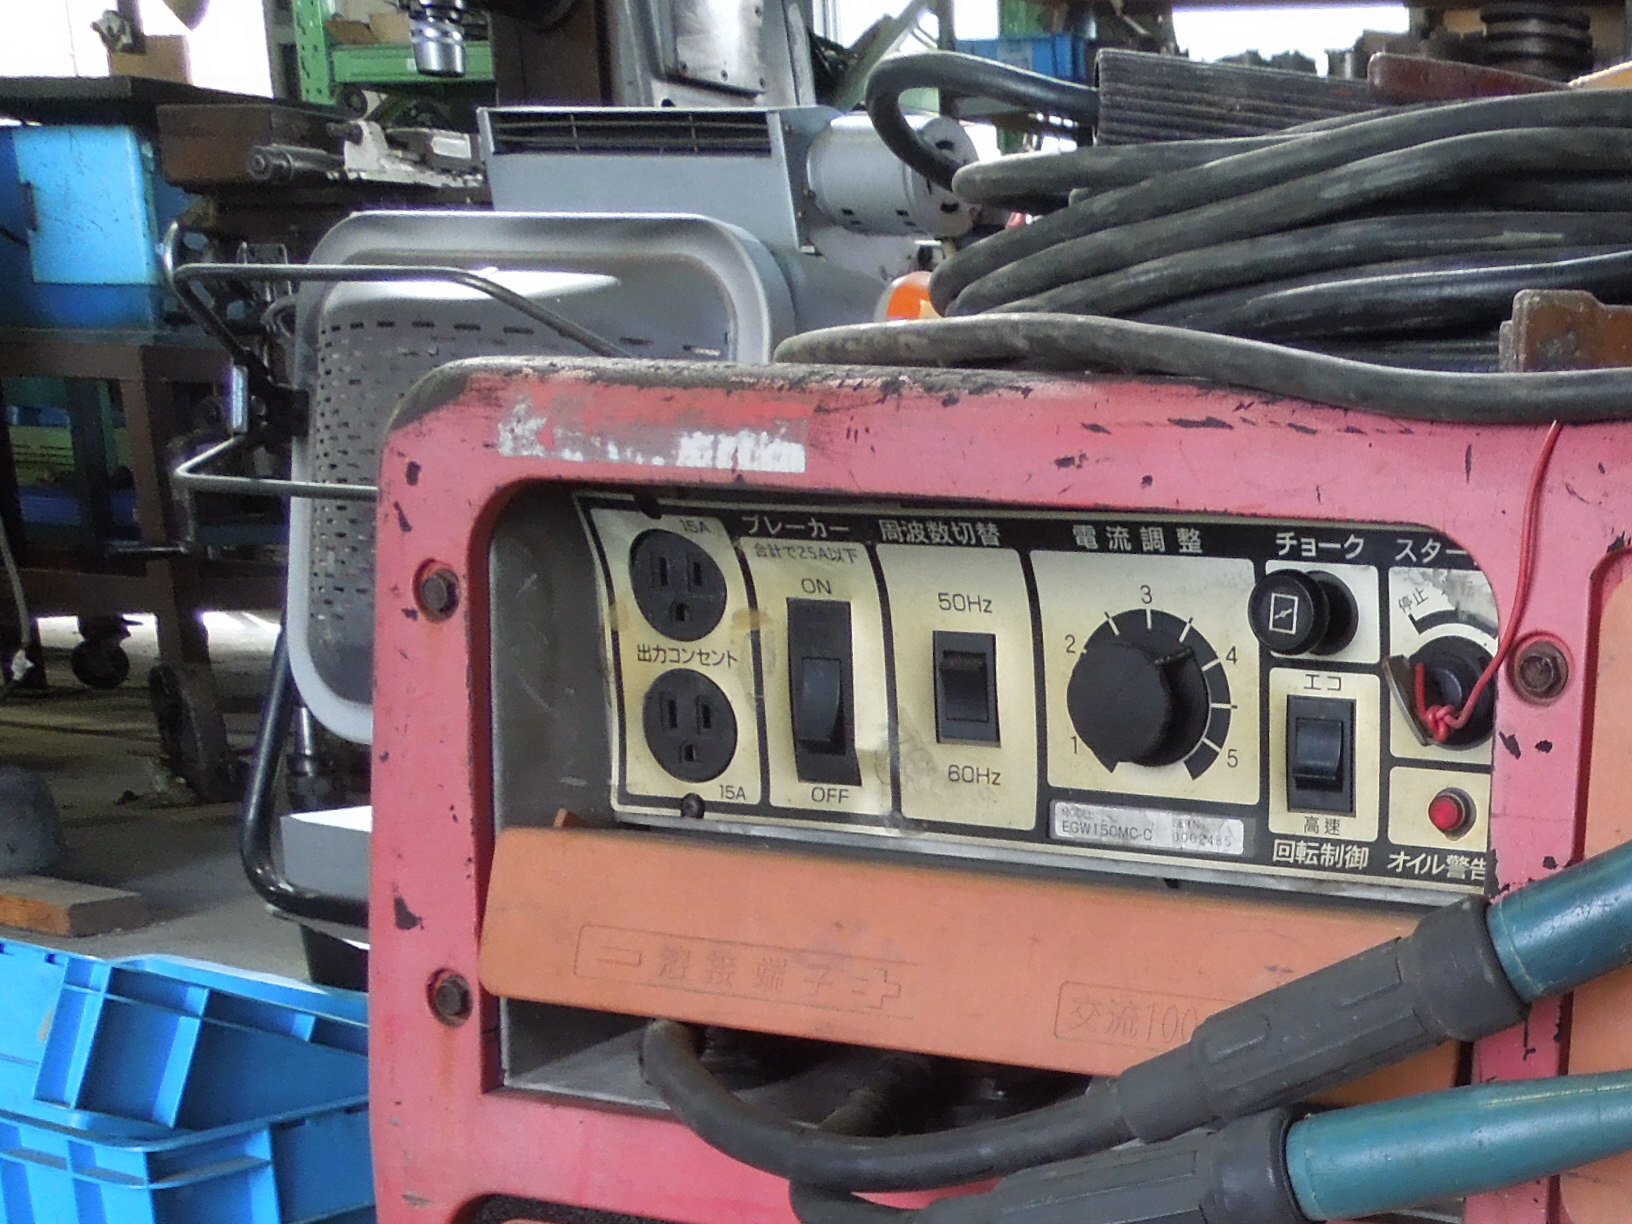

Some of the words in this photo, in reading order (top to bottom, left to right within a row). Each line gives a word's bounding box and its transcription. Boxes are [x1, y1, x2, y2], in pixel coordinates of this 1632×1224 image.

[680, 518, 711, 534] 15A
[879, 519, 1001, 547] 周波数切替
[1072, 524, 1203, 553] 電流調整
[1275, 531, 1365, 560] チョーク
[1395, 537, 1478, 567] スター
[801, 577, 833, 595] ON
[1140, 584, 1153, 604] 3
[938, 592, 993, 614] 50Hz
[1064, 634, 1076, 654] 2
[637, 643, 738, 668] 出力コンセント
[1225, 646, 1238, 664] 4
[1303, 673, 1342, 692] エコ
[1226, 749, 1239, 768] 5
[947, 764, 1001, 786] 60Hz
[719, 783, 746, 802] 15A
[811, 786, 850, 804] OFF
[1303, 816, 1341, 836] 高速
[1272, 839, 1370, 869] 回転制御
[1387, 851, 1487, 881] オイル警告
